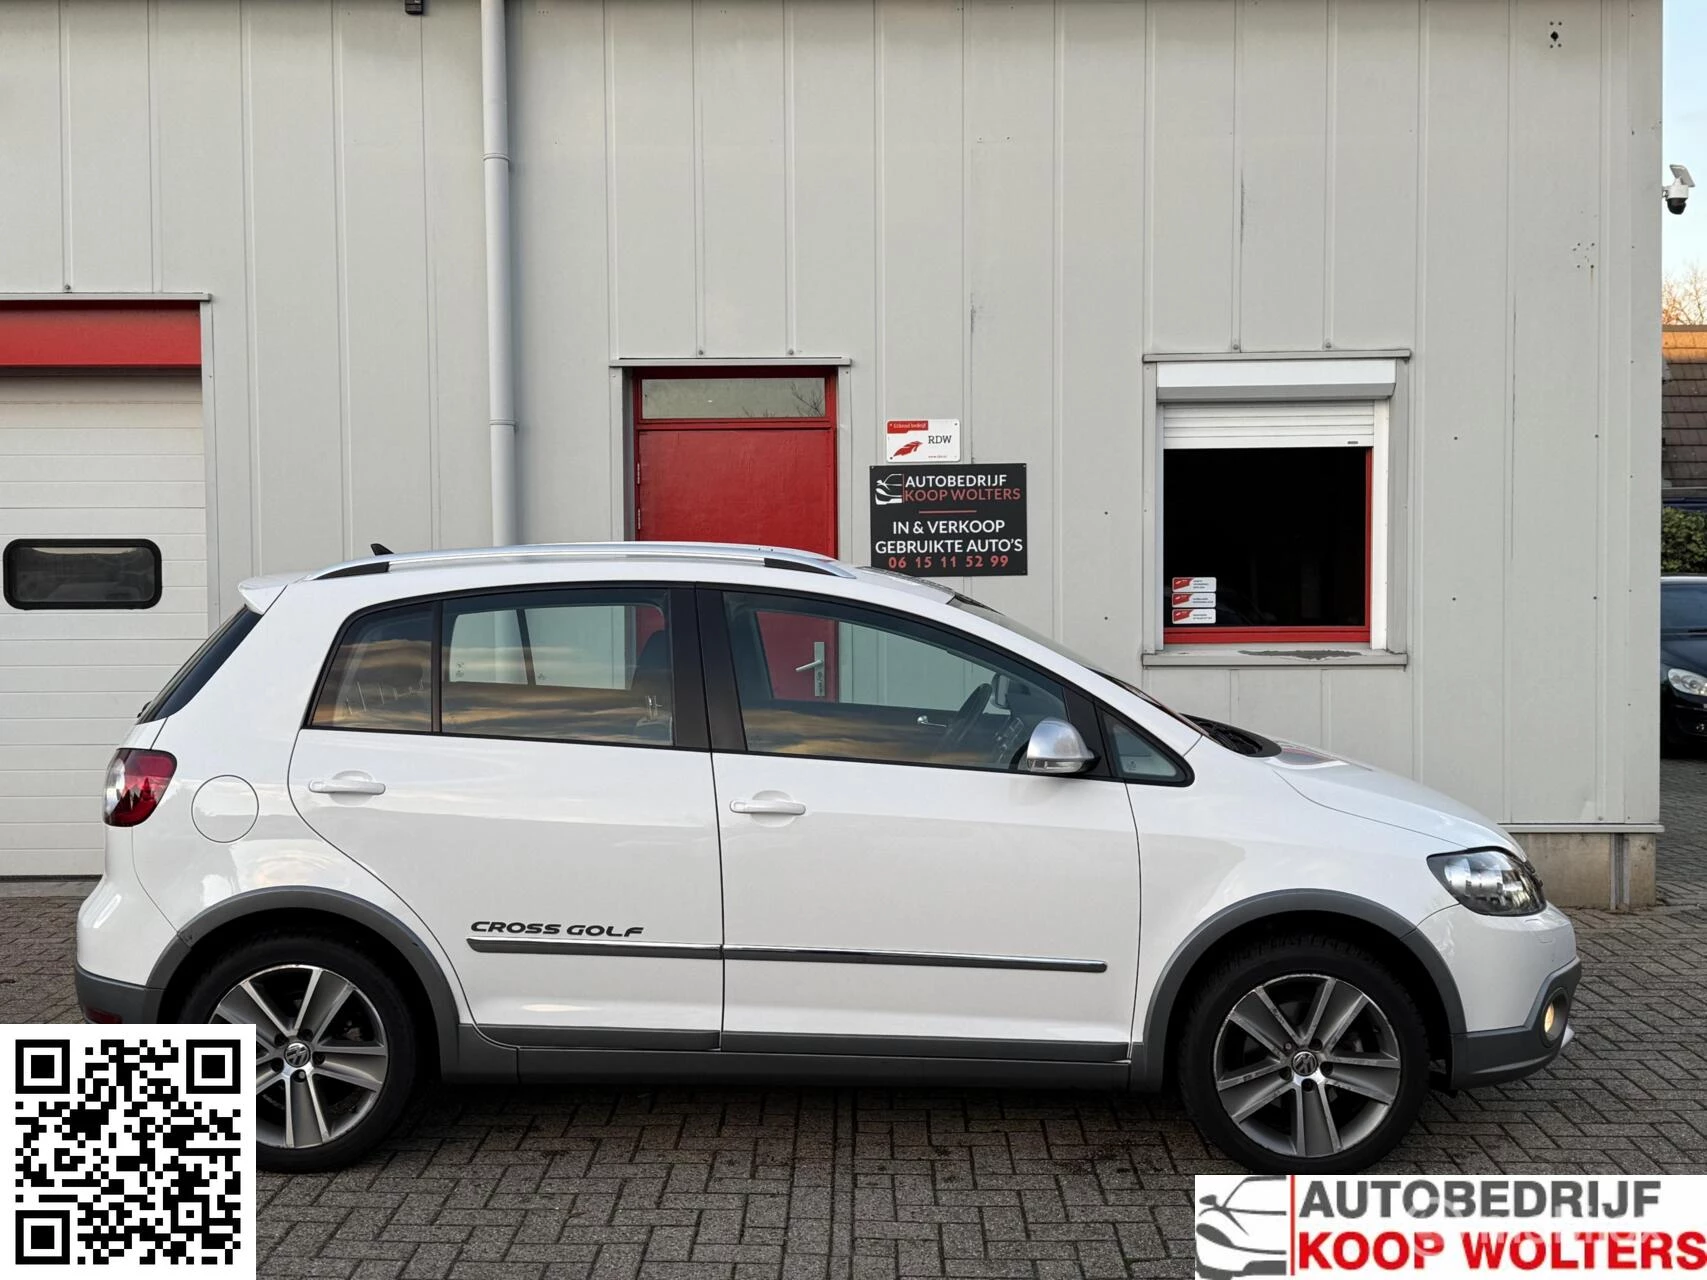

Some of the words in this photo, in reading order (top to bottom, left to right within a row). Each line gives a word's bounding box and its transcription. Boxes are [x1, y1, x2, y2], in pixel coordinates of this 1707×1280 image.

[928, 436, 952, 444] RDW
[905, 474, 1007, 488] AUTOBEDRIJF
[905, 489, 948, 502] KOOP
[950, 488, 1021, 501] WOLTERS
[893, 521, 909, 534] IN
[913, 521, 924, 534] &
[927, 519, 1005, 533] VERKOOP
[875, 540, 963, 554] GEBRUIKTE
[966, 538, 1023, 552] AUTO'S
[888, 557, 906, 568] 06
[915, 557, 932, 568] 15
[941, 557, 957, 567] 11
[965, 555, 983, 567] 52
[990, 555, 1009, 567] 99
[471, 921, 561, 934] CROSS
[566, 925, 644, 937] GOLF
